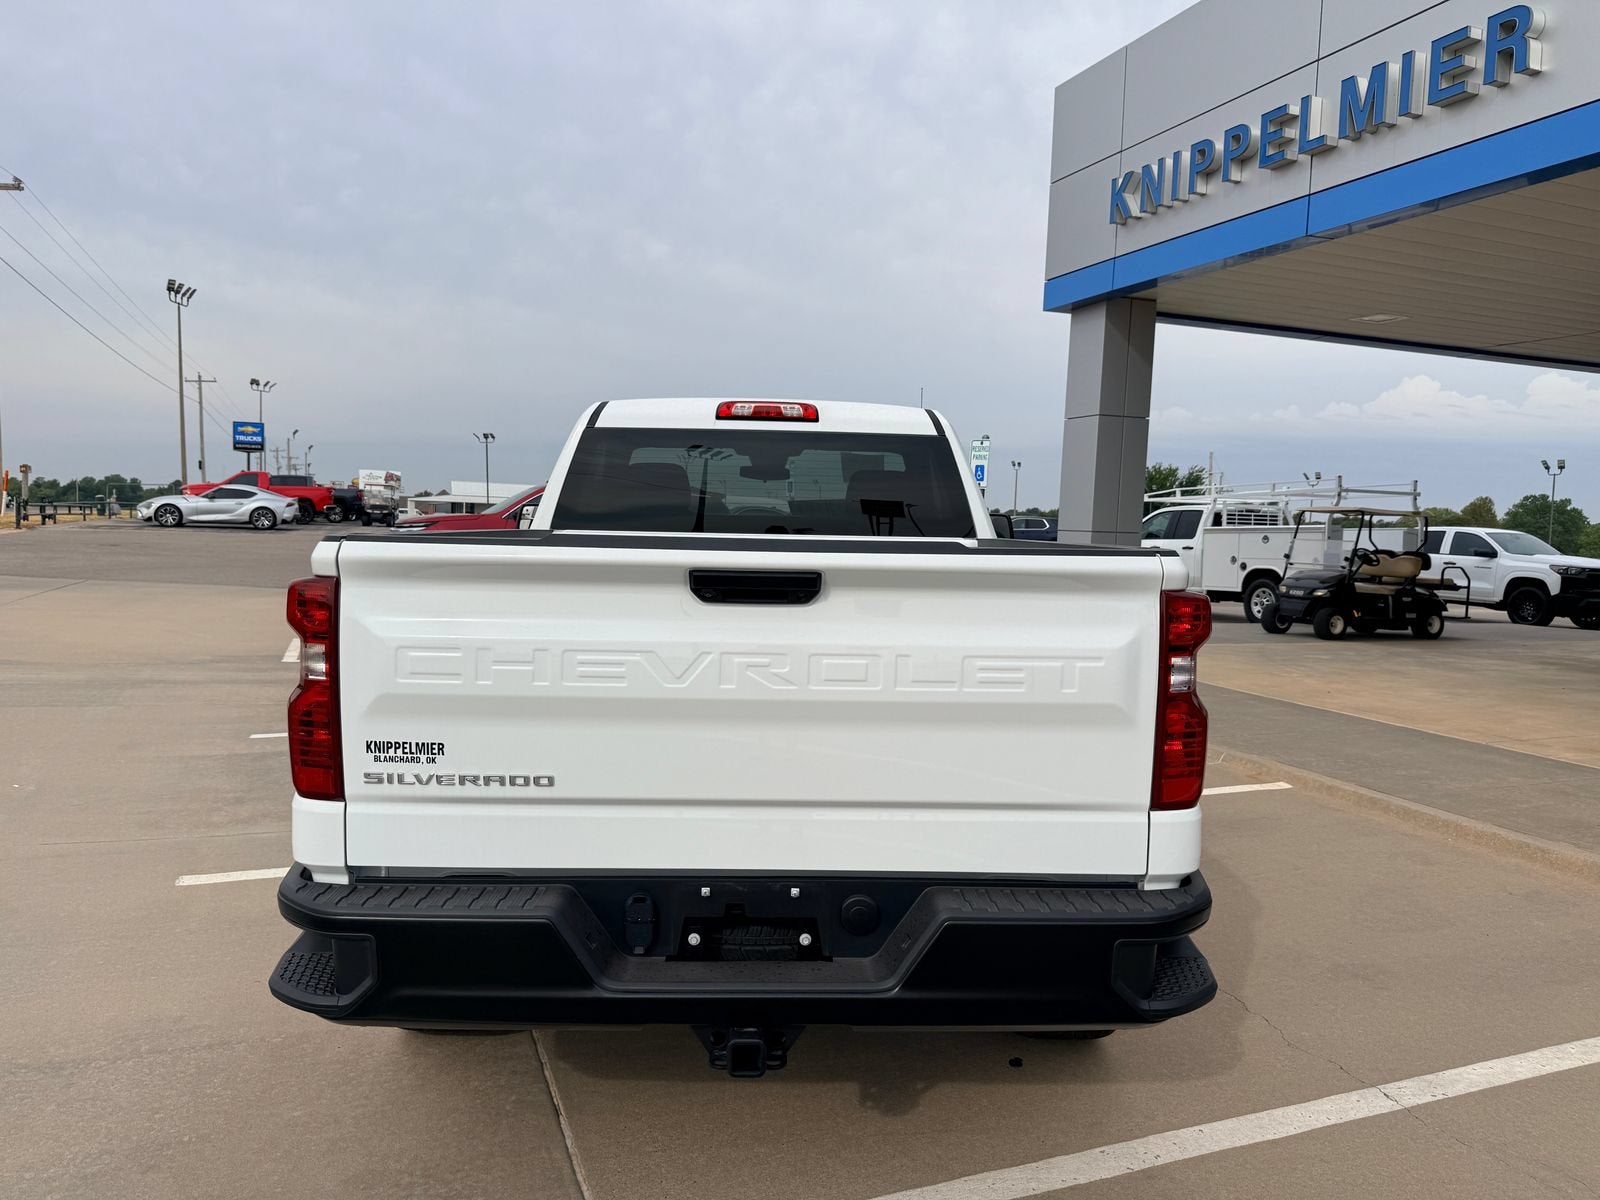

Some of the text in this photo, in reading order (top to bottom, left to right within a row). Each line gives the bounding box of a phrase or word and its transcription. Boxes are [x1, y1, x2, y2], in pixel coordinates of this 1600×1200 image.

[1109, 4, 1545, 225] KNIPPELMIER
[396, 646, 1106, 694] CHEVROLET
[365, 740, 445, 756] KNIPPELMIER
[373, 755, 437, 765] BLANCHARD, OK
[363, 772, 556, 788] SILVERADO
